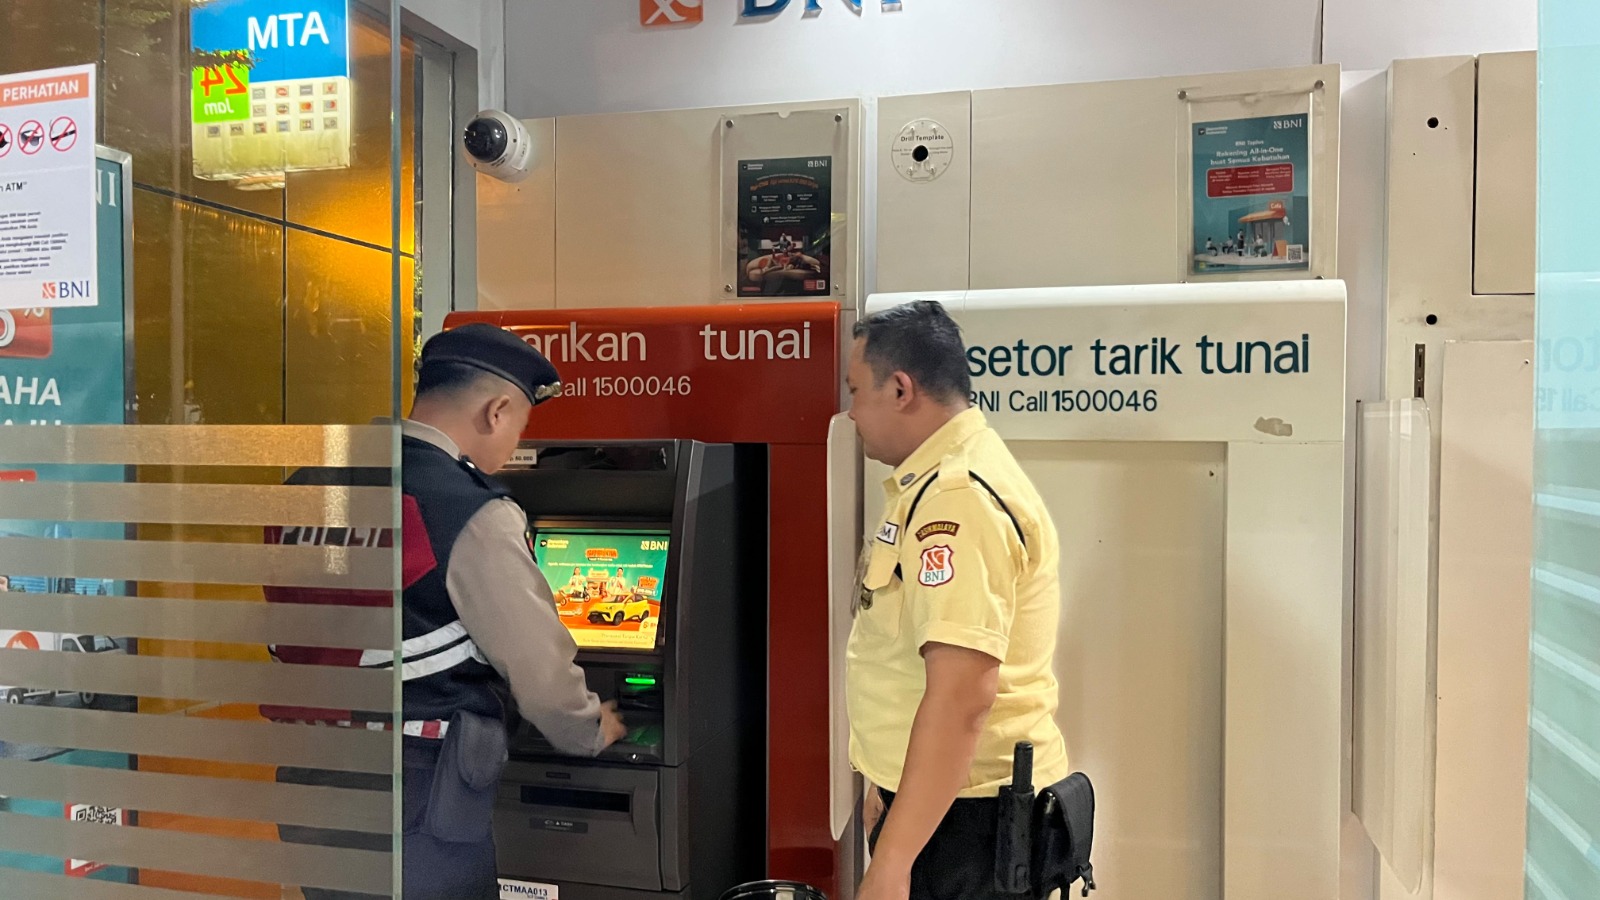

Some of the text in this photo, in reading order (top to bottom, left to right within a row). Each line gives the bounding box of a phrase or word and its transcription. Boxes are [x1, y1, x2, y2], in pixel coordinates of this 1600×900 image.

[3, 79, 79, 102] PERHATIAN
[1284, 118, 1302, 129] BNI
[916, 134, 945, 142] Template
[59, 280, 91, 298] BNI
[699, 321, 811, 361] tunai
[965, 333, 1310, 377] setor tarik tunai
[592, 375, 692, 397] 1500046
[1008, 389, 1048, 413] Call
[1051, 389, 1158, 413] 1500046
[649, 541, 668, 551] BNI
[924, 570, 945, 583] BNI
